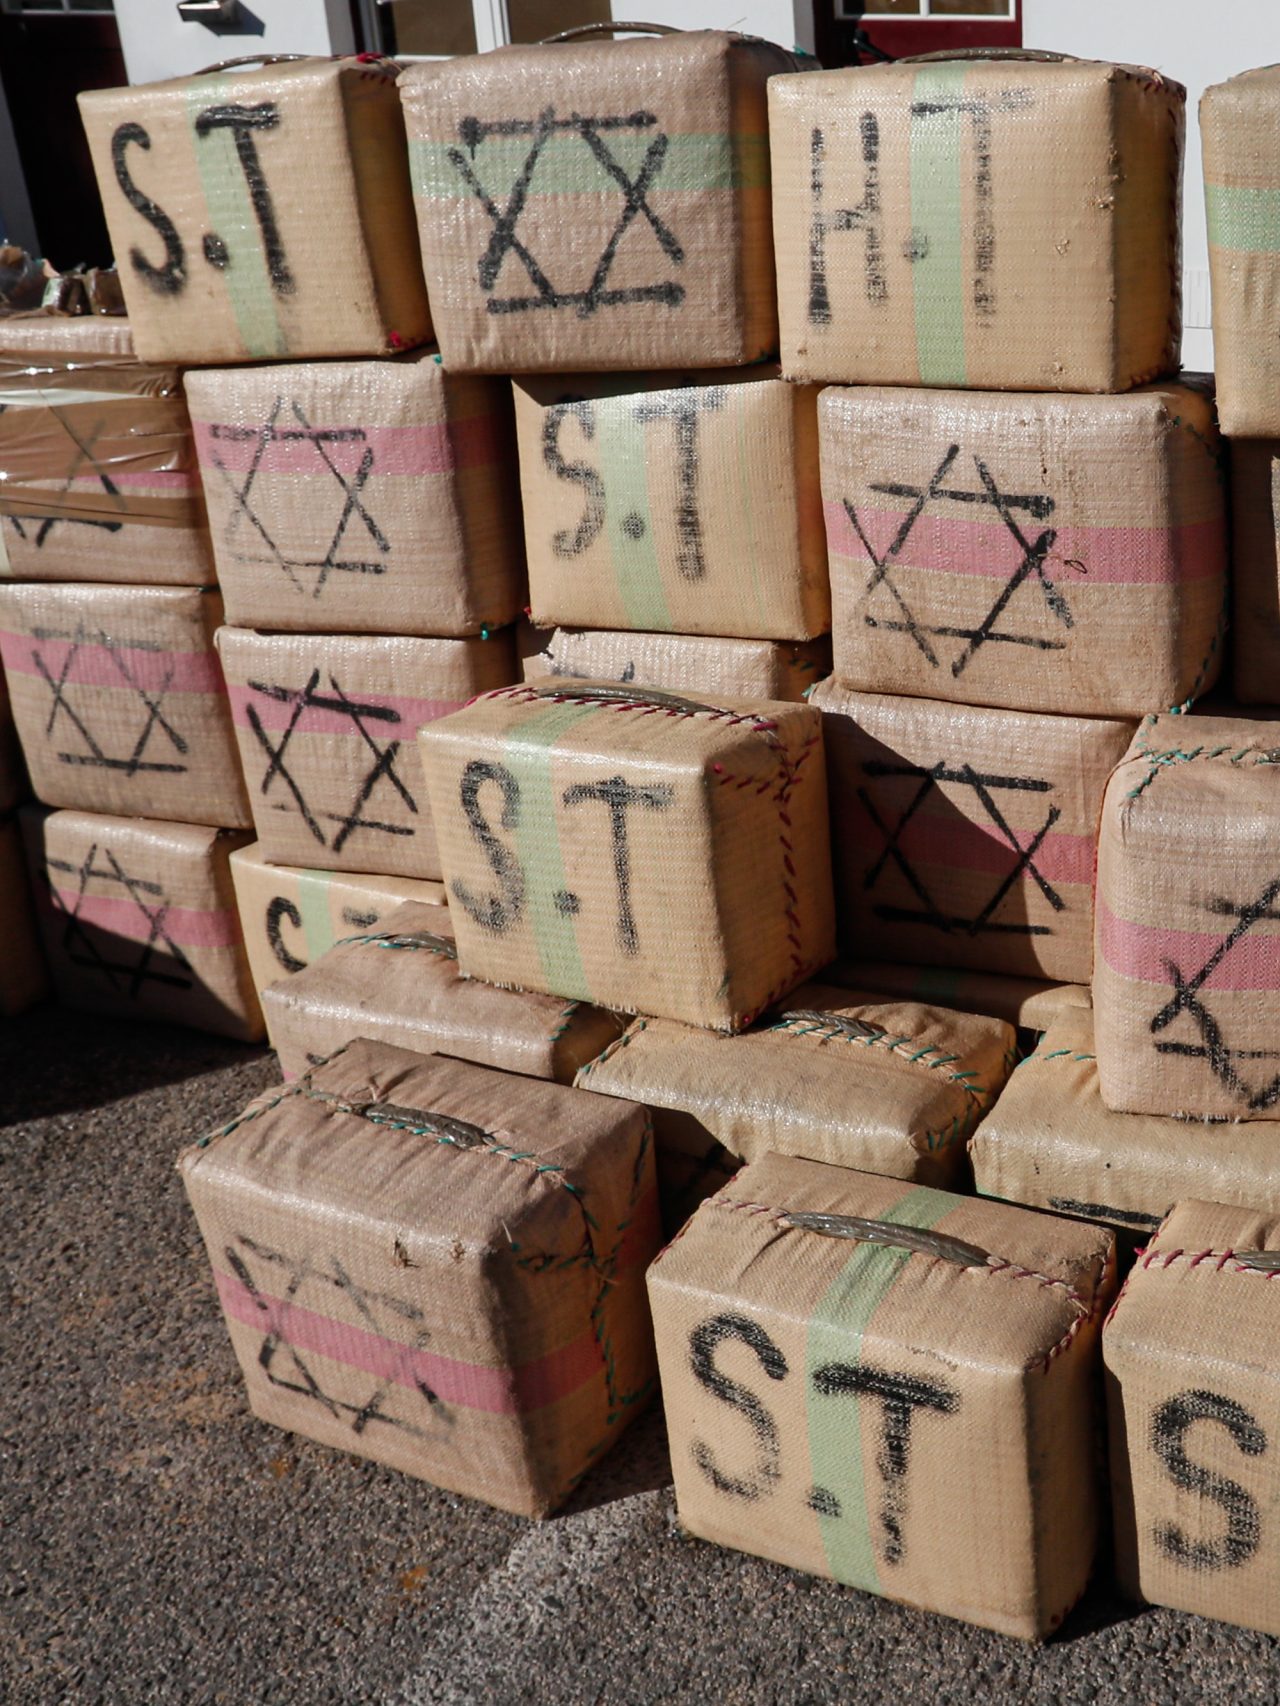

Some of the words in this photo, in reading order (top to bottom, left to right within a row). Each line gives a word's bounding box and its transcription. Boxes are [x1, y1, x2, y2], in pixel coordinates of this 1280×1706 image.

[111, 102, 296, 297] S.T
[541, 383, 728, 582] S.T
[450, 760, 675, 955] S.T
[688, 1313, 960, 1566] S.T
